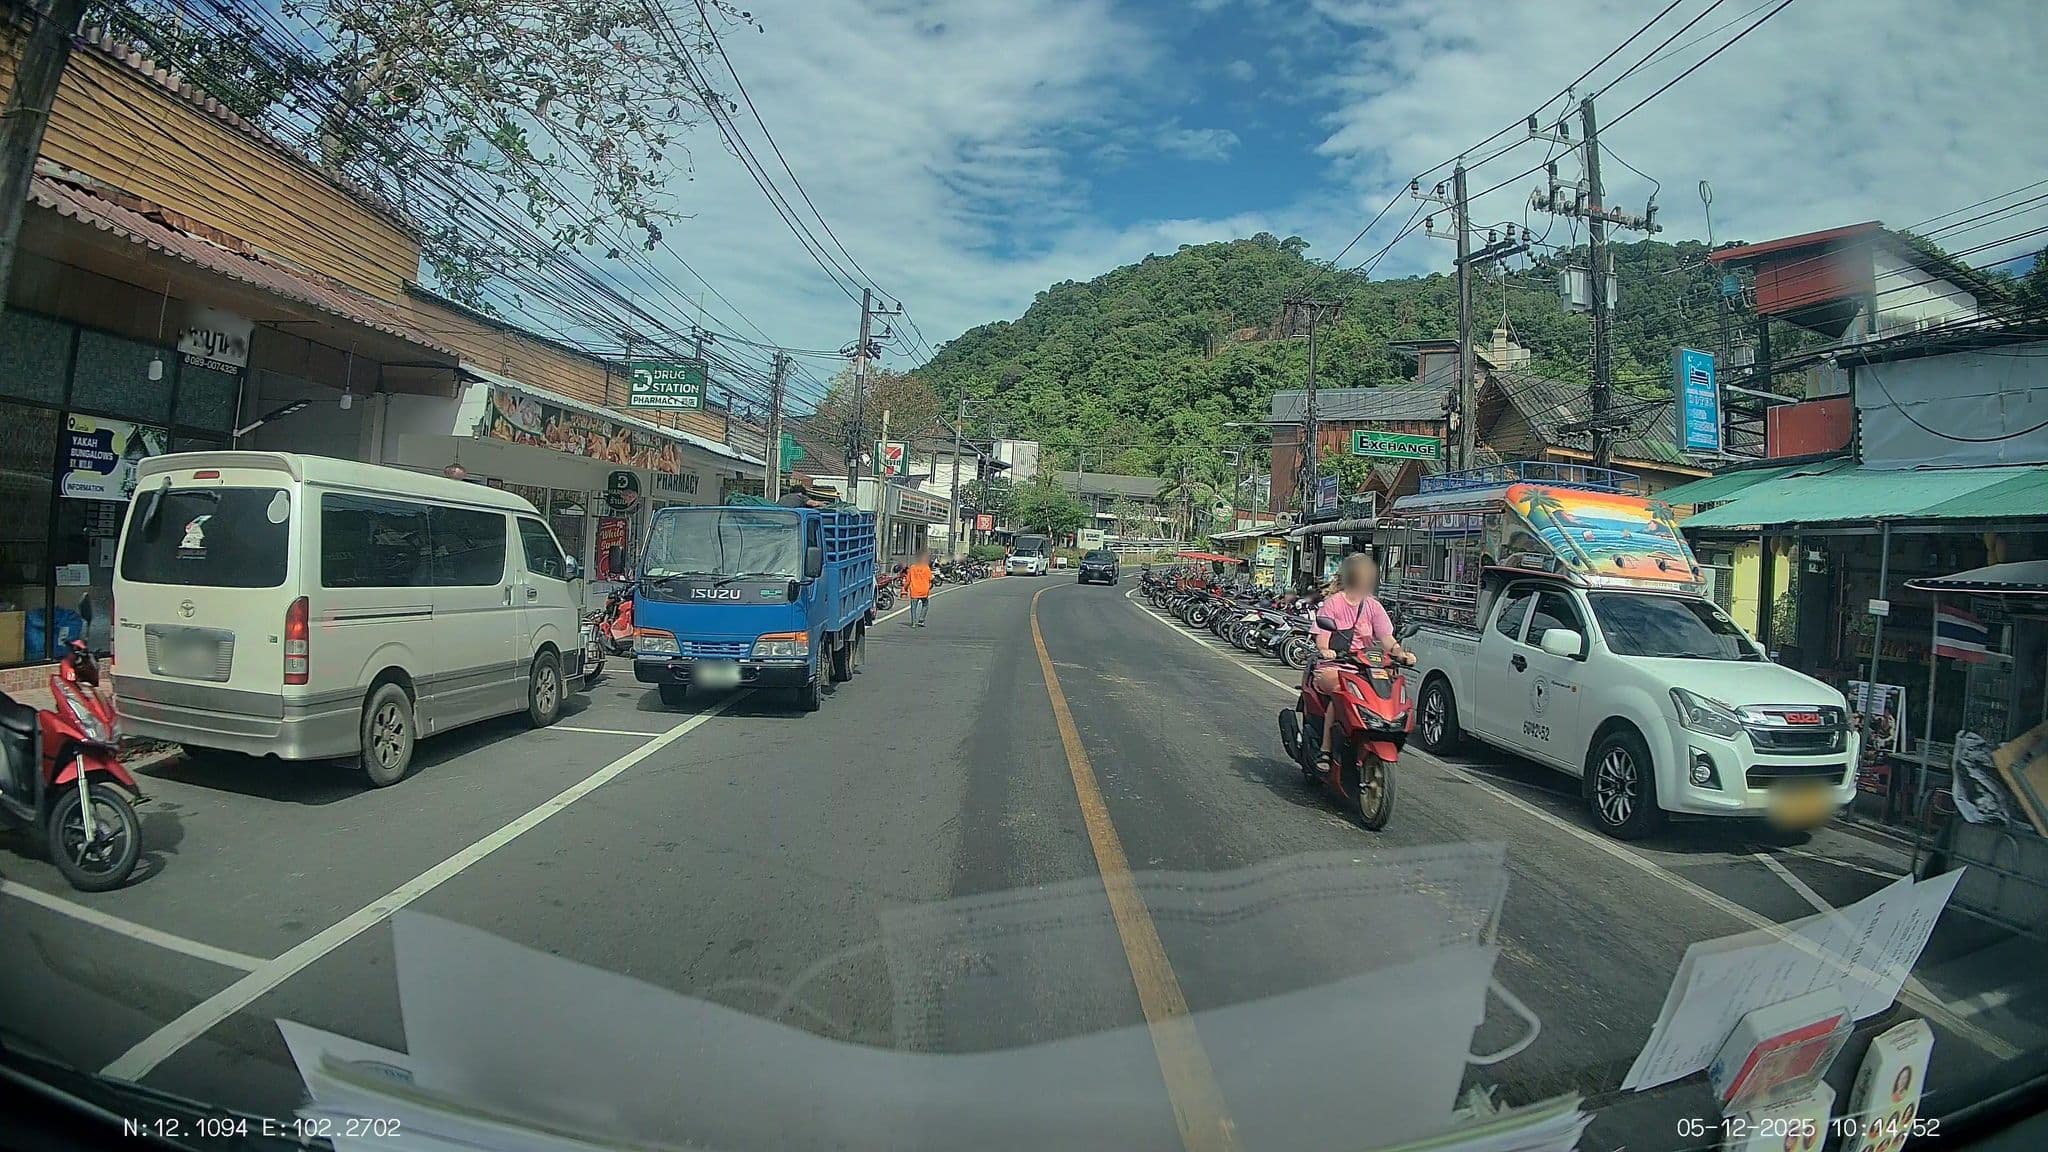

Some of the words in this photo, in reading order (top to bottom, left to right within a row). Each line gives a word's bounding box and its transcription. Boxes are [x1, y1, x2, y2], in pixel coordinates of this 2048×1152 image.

[653, 369, 686, 380] DRUG
[652, 383, 700, 394] STATION
[633, 396, 678, 405] PHARMACY
[72, 436, 98, 448] YAKAH
[1359, 435, 1436, 454] EXCHANGE
[70, 448, 114, 461] BUNGALOWS
[67, 482, 105, 493] INFORMATION
[656, 472, 700, 495] PHARMACY
[691, 588, 741, 600] ISUZU
[1785, 711, 1820, 723] ISUZU
